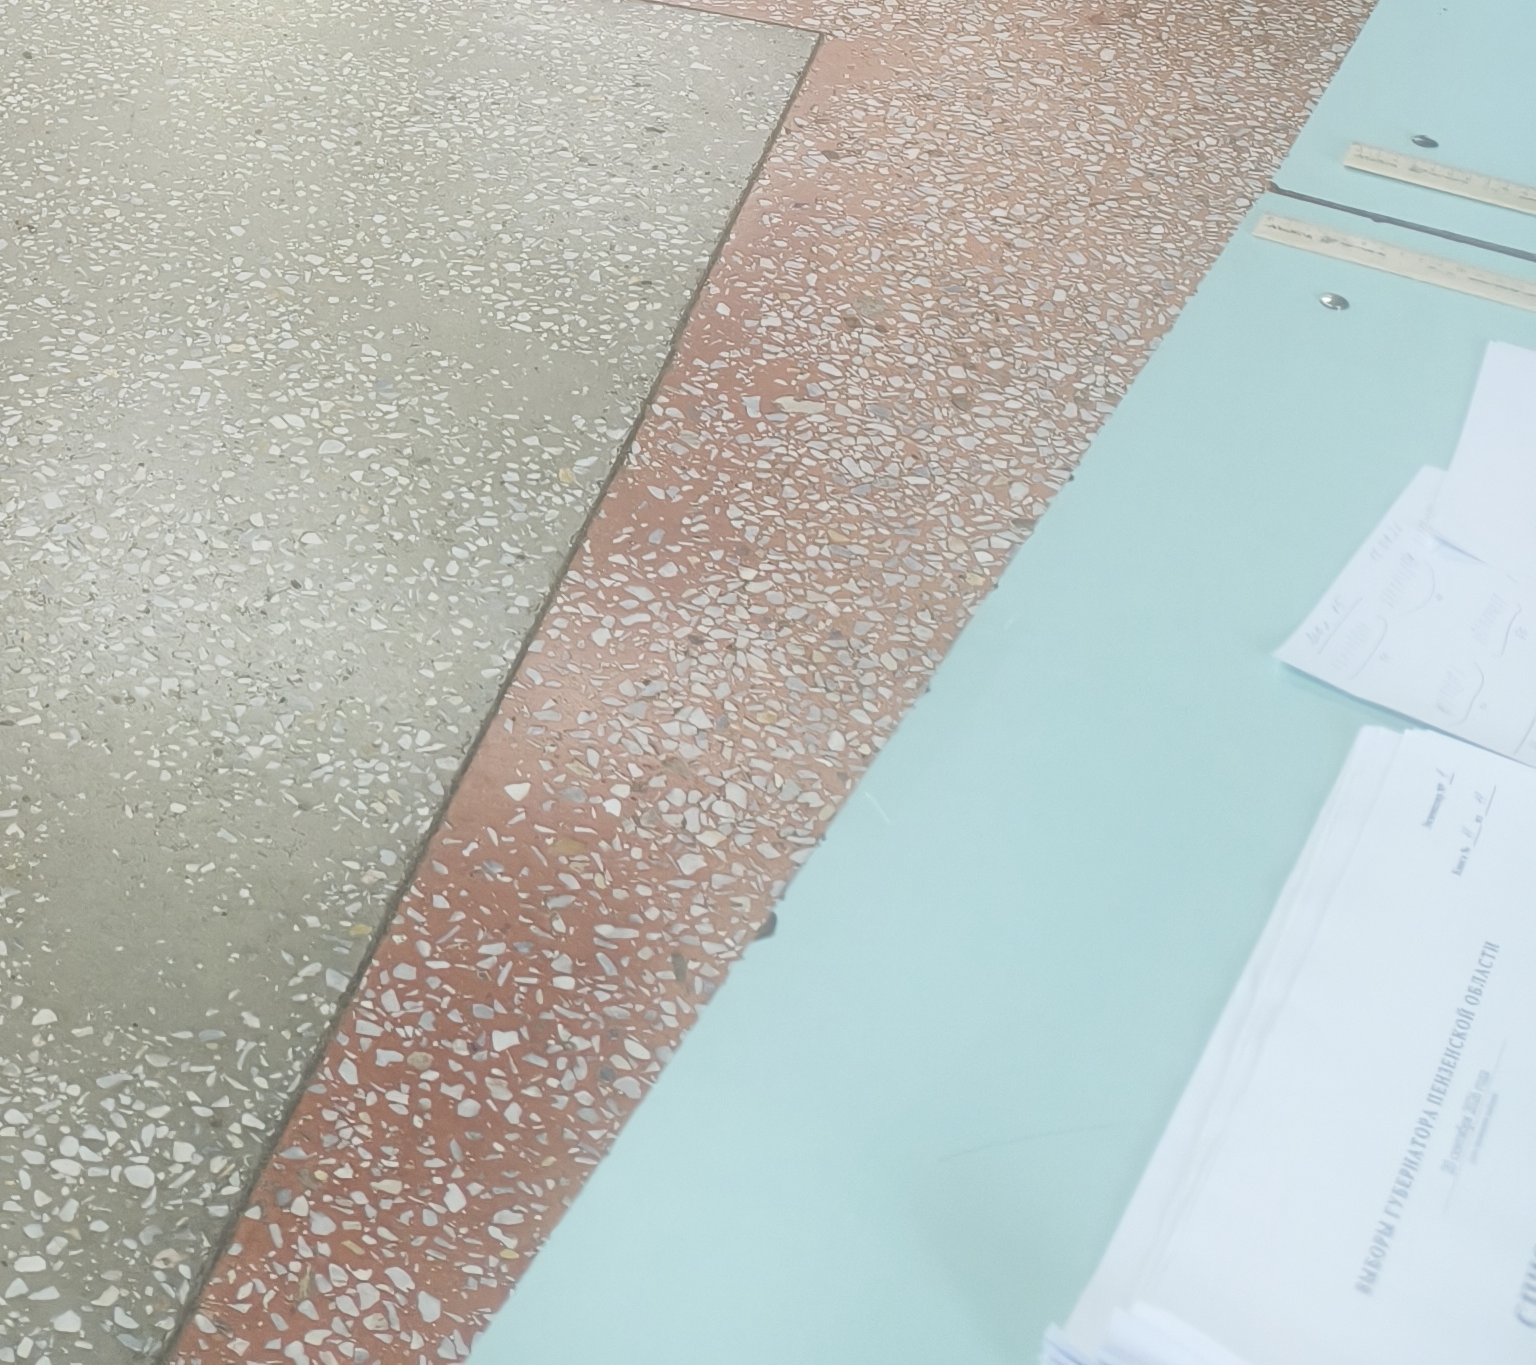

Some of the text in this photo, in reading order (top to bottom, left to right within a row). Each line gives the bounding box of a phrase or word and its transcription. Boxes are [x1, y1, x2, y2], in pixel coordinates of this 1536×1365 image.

[1354, 940, 1501, 1297] ВЫБОРЫ ГУБЕРНАТОРА ПЕНЗЕНСКОЙ ОБЛАСТИ
